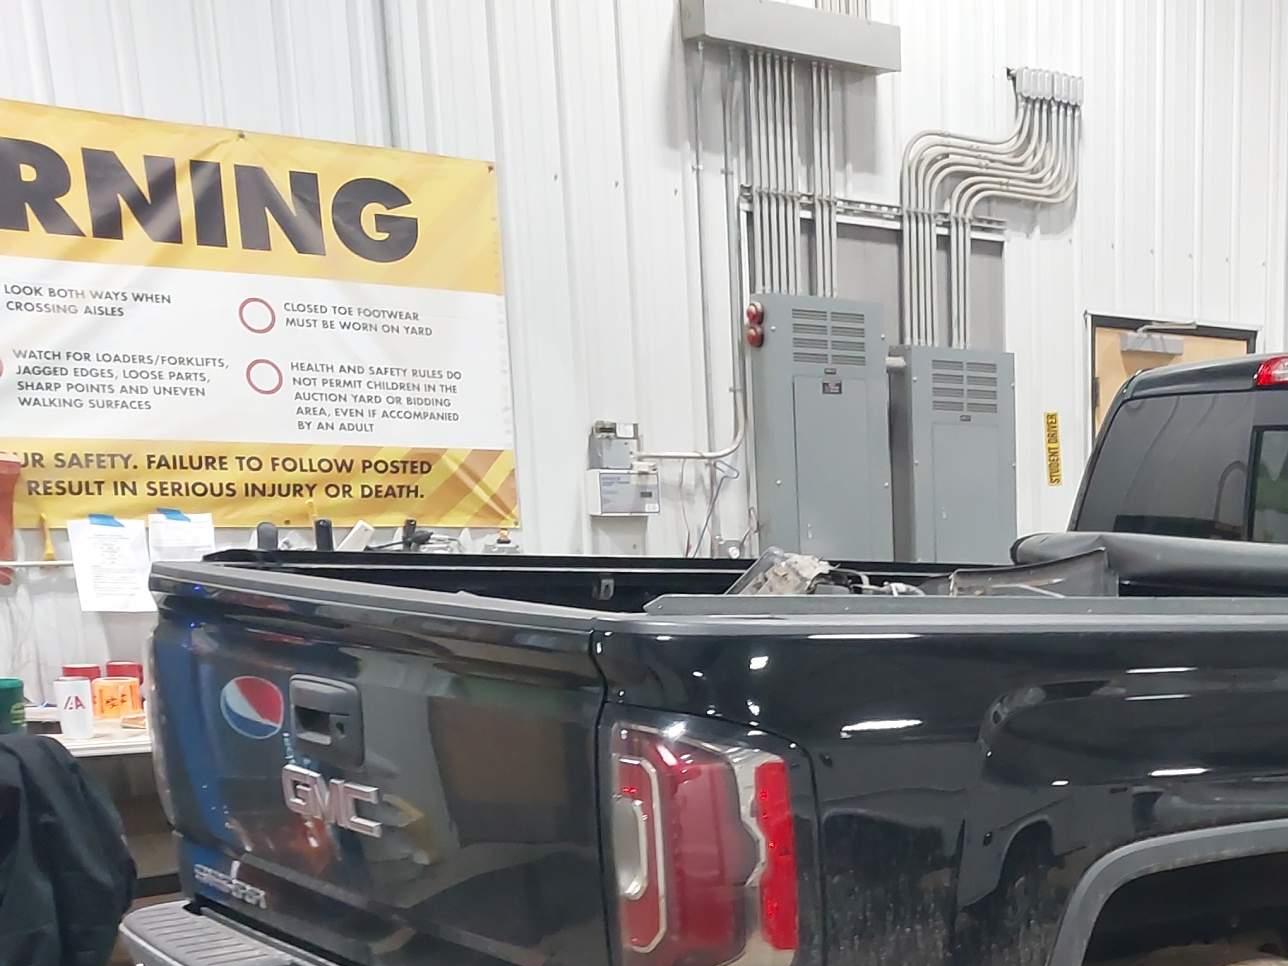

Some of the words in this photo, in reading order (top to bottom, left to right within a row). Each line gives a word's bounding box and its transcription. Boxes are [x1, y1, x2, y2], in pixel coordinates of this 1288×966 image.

[5, 285, 43, 296] LOOK
[48, 288, 84, 299] BOTH
[90, 290, 128, 301] WAYS
[132, 292, 171, 304] WHEN
[6, 301, 78, 314] CROSSING
[84, 306, 124, 316] AISLES
[284, 303, 327, 314] CLOSED
[332, 306, 353, 316] TOE
[357, 308, 419, 320] FOOTWEAR
[286, 317, 317, 328] MUST
[322, 320, 335, 329] BE
[340, 321, 377, 332] WORN
[382, 325, 399, 334] ON
[403, 326, 432, 336] YARD
[12, 349, 61, 360] WATCH
[66, 352, 91, 362] FOR
[96, 353, 229, 369] LOADERS/FORKLIFTS,
[16, 366, 68, 376] JAGGED
[74, 368, 118, 379] EDGES,
[123, 370, 164, 380] LOOSE
[169, 372, 210, 383] PARTS,
[291, 362, 334, 373] HEALTH
[339, 365, 365, 374] AND
[369, 367, 407, 377] SAFETY
[412, 369, 443, 379] RULES
[447, 371, 462, 380] DO
[17, 381, 62, 392] SHARP
[67, 383, 114, 394] POINTS
[120, 385, 149, 395] AND
[153, 386, 206, 396] UNEVEN
[293, 377, 317, 386] NOT
[322, 379, 362, 389] PERMIT
[366, 380, 420, 391] CHILDREN
[425, 384, 435, 392] IN
[440, 384, 457, 393] THE
[18, 397, 84, 408] WALKING
[89, 399, 151, 410] SURFACES
[295, 392, 347, 402] AUCTION
[351, 394, 382, 404] YARD
[386, 396, 402, 405] OR
[407, 397, 451, 407] BIDDING
[296, 407, 331, 417] AREA,
[335, 408, 364, 418] EVEN
[368, 410, 376, 418] IF
[381, 410, 459, 421] ACCOMPANIED
[298, 422, 311, 430] BY
[317, 422, 334, 431] AN
[339, 423, 374, 432] ADULT
[1046, 414, 1058, 443] DRIVER
[54, 453, 138, 470] SAFETY.
[147, 454, 228, 471] FAILURE
[236, 456, 263, 471] TO
[271, 457, 354, 473] FOLLOW
[361, 460, 432, 475] POSTED
[1047, 447, 1061, 484] STUDENT
[27, 480, 104, 496] RESULT
[114, 481, 137, 496] IN
[147, 481, 236, 497] SERIOUS
[244, 483, 317, 498] INJURY
[325, 484, 352, 499] OR
[361, 484, 424, 499] DEATH.
[282, 764, 381, 838] GMC
